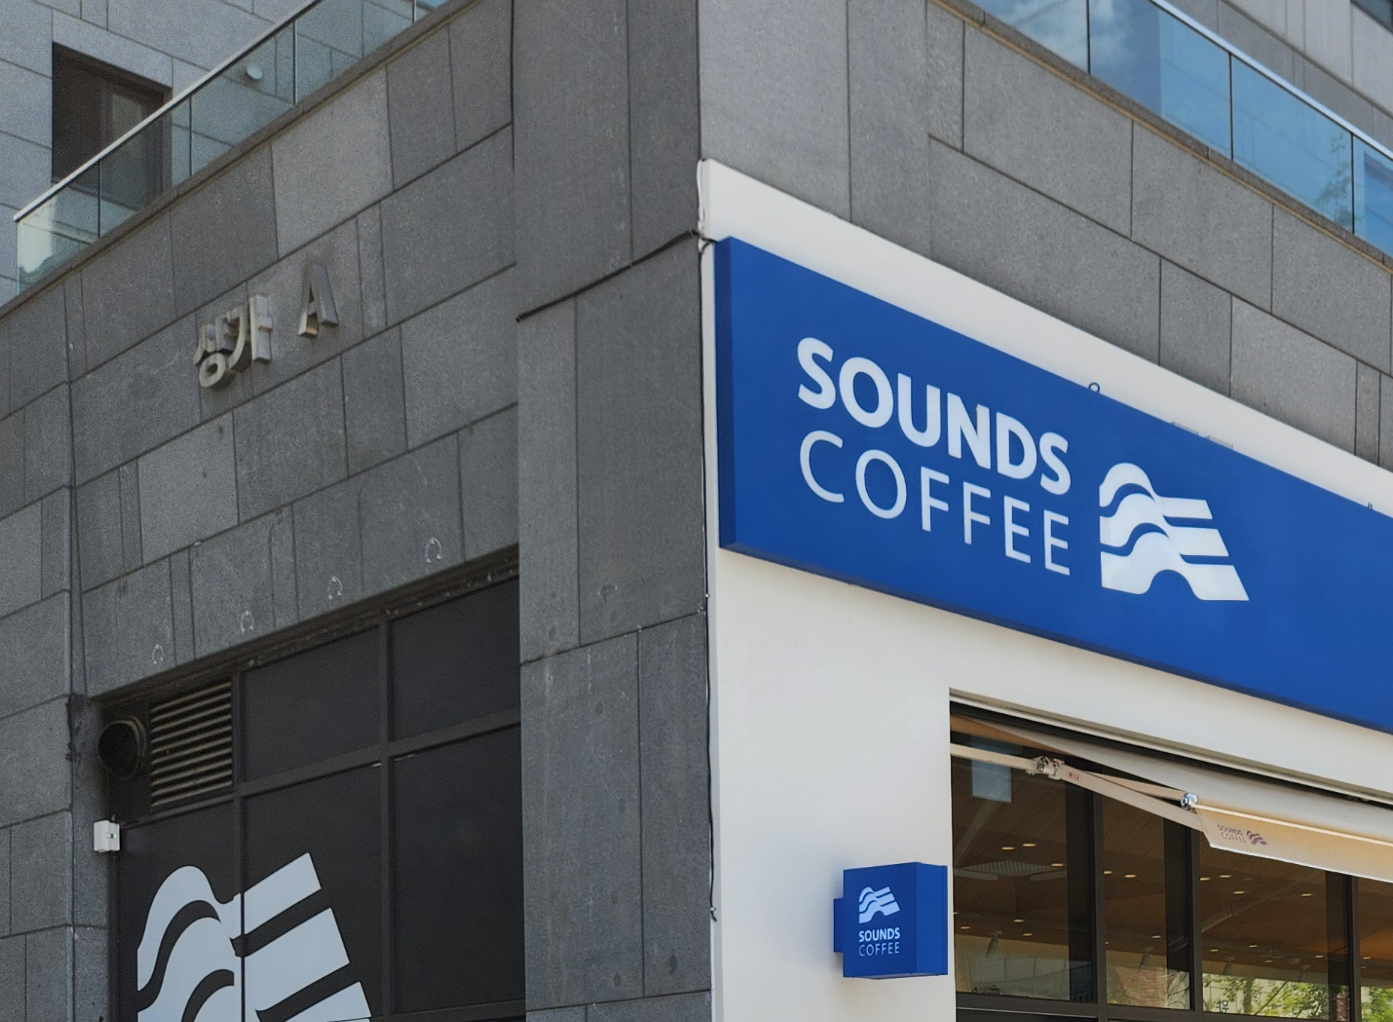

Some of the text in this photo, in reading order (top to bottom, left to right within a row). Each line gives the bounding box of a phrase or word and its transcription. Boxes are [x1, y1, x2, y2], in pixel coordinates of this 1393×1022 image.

[299, 263, 339, 337] A
[797, 337, 1071, 495] SOUNDS
[799, 430, 1070, 576] COFFEE
[858, 927, 900, 942] SOUNDS
[858, 941, 900, 957] COFFEE
